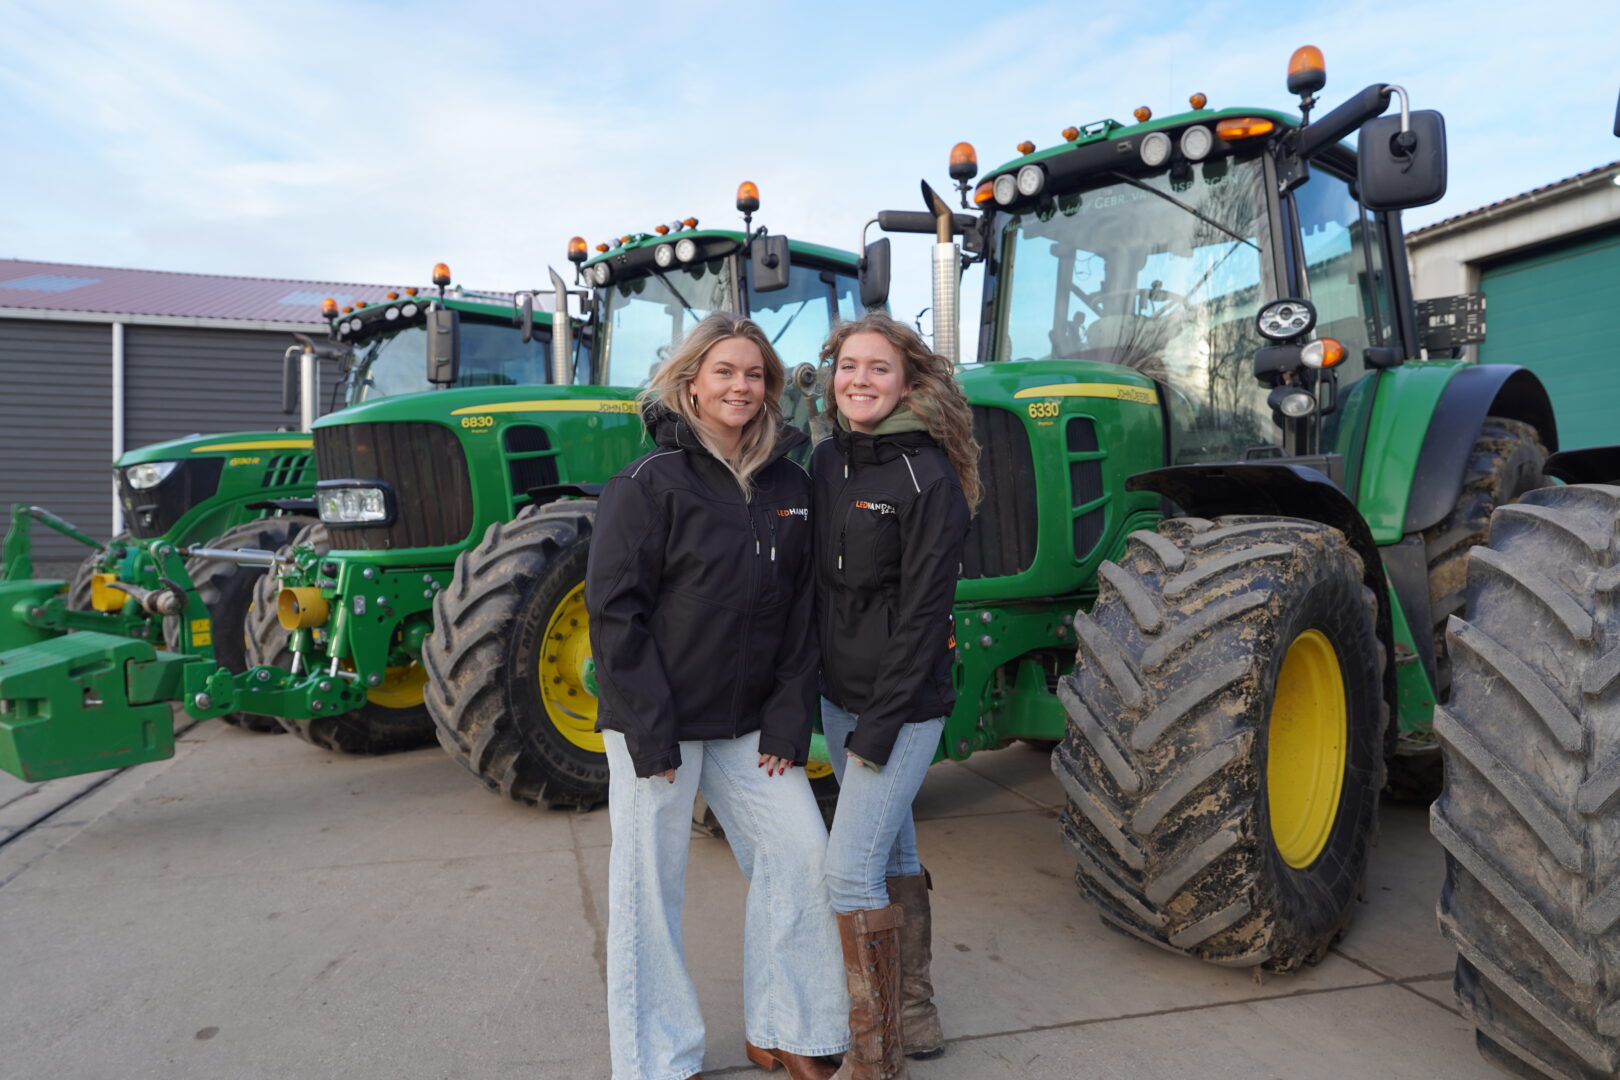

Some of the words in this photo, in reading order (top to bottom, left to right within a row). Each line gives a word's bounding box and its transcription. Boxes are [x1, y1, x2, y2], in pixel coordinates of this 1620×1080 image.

[1028, 402, 1059, 418] 6330
[461, 416, 493, 428] 6830
[776, 508, 809, 517] LEDHAND
